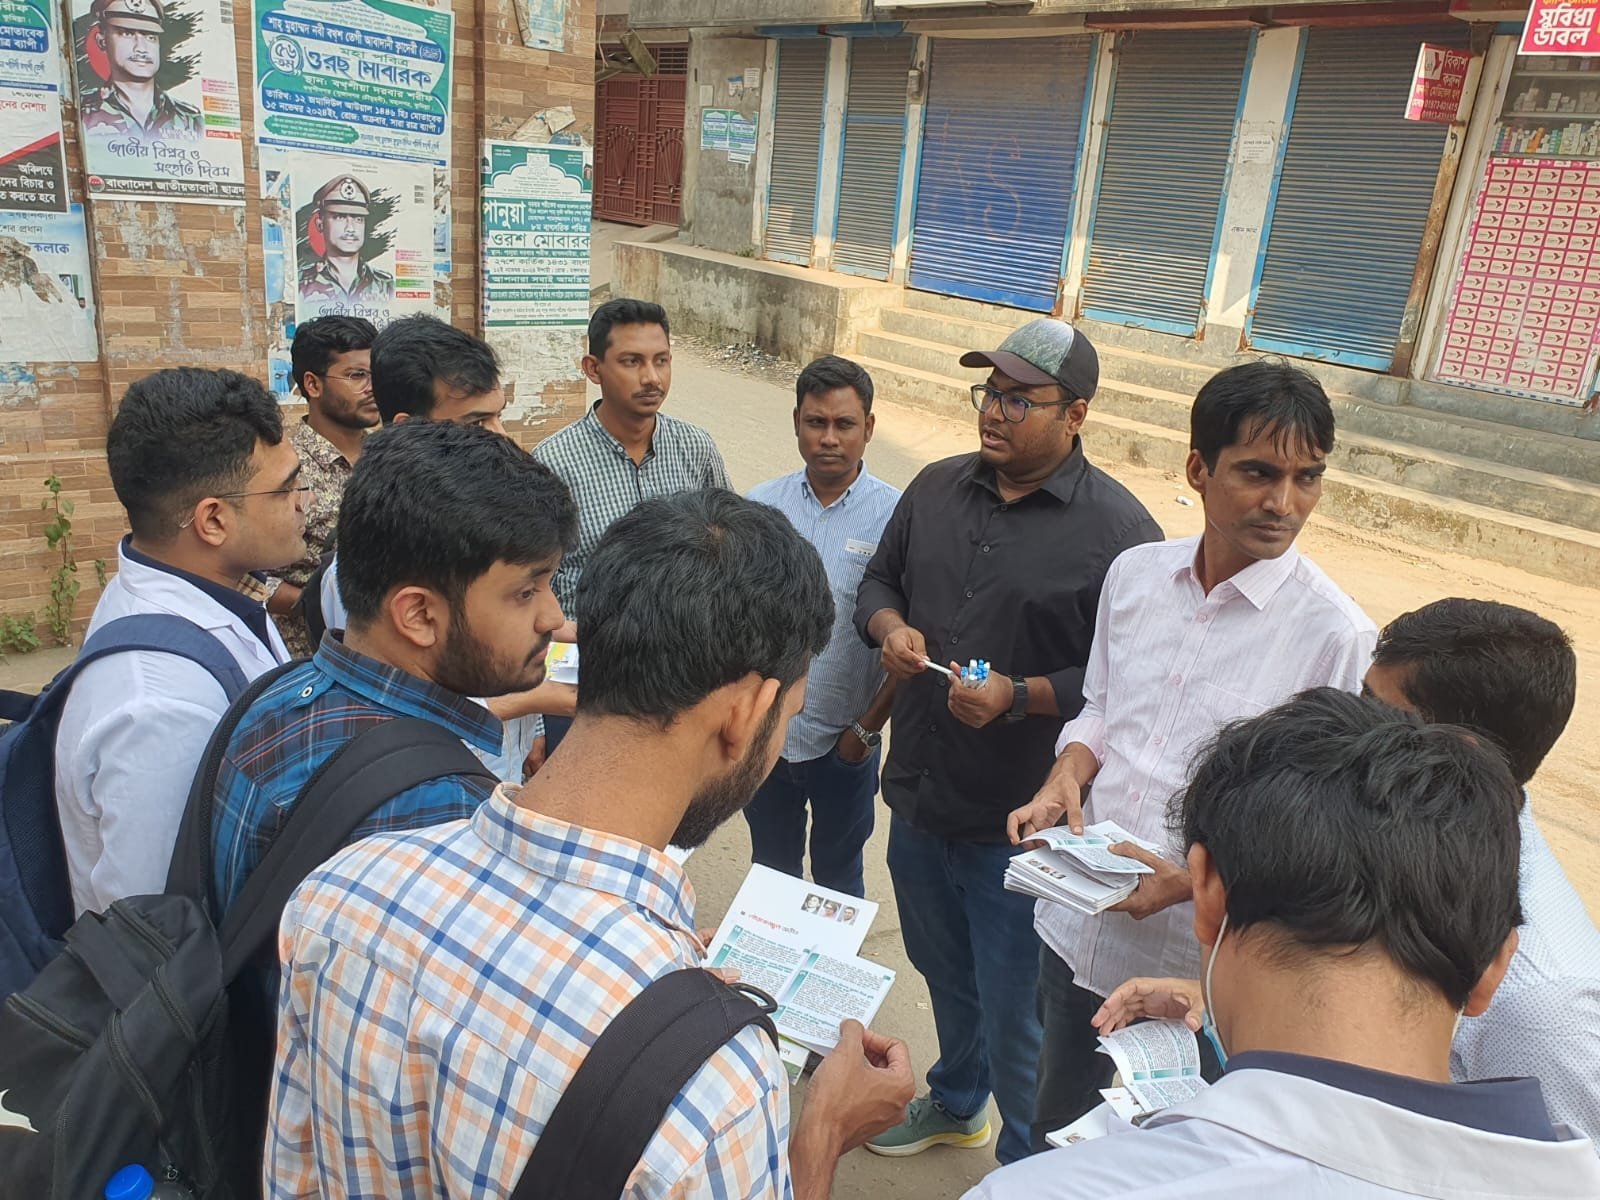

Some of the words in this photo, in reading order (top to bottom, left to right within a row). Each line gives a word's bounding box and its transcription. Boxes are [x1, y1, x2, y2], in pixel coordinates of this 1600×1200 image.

[1537, 2, 1597, 28] সুবিধা
[1533, 27, 1591, 46] ডাবল
[358, 60, 432, 89] মোবারক
[108, 137, 149, 158] জাতীয়
[190, 150, 200, 160] ও
[154, 159, 194, 177] সংহতি
[198, 160, 230, 178] দিবস
[106, 178, 153, 190] বাংলাদেশ
[483, 199, 526, 230] পানুয়া
[491, 233, 526, 247] ওরশ
[383, 308, 390, 317] ও
